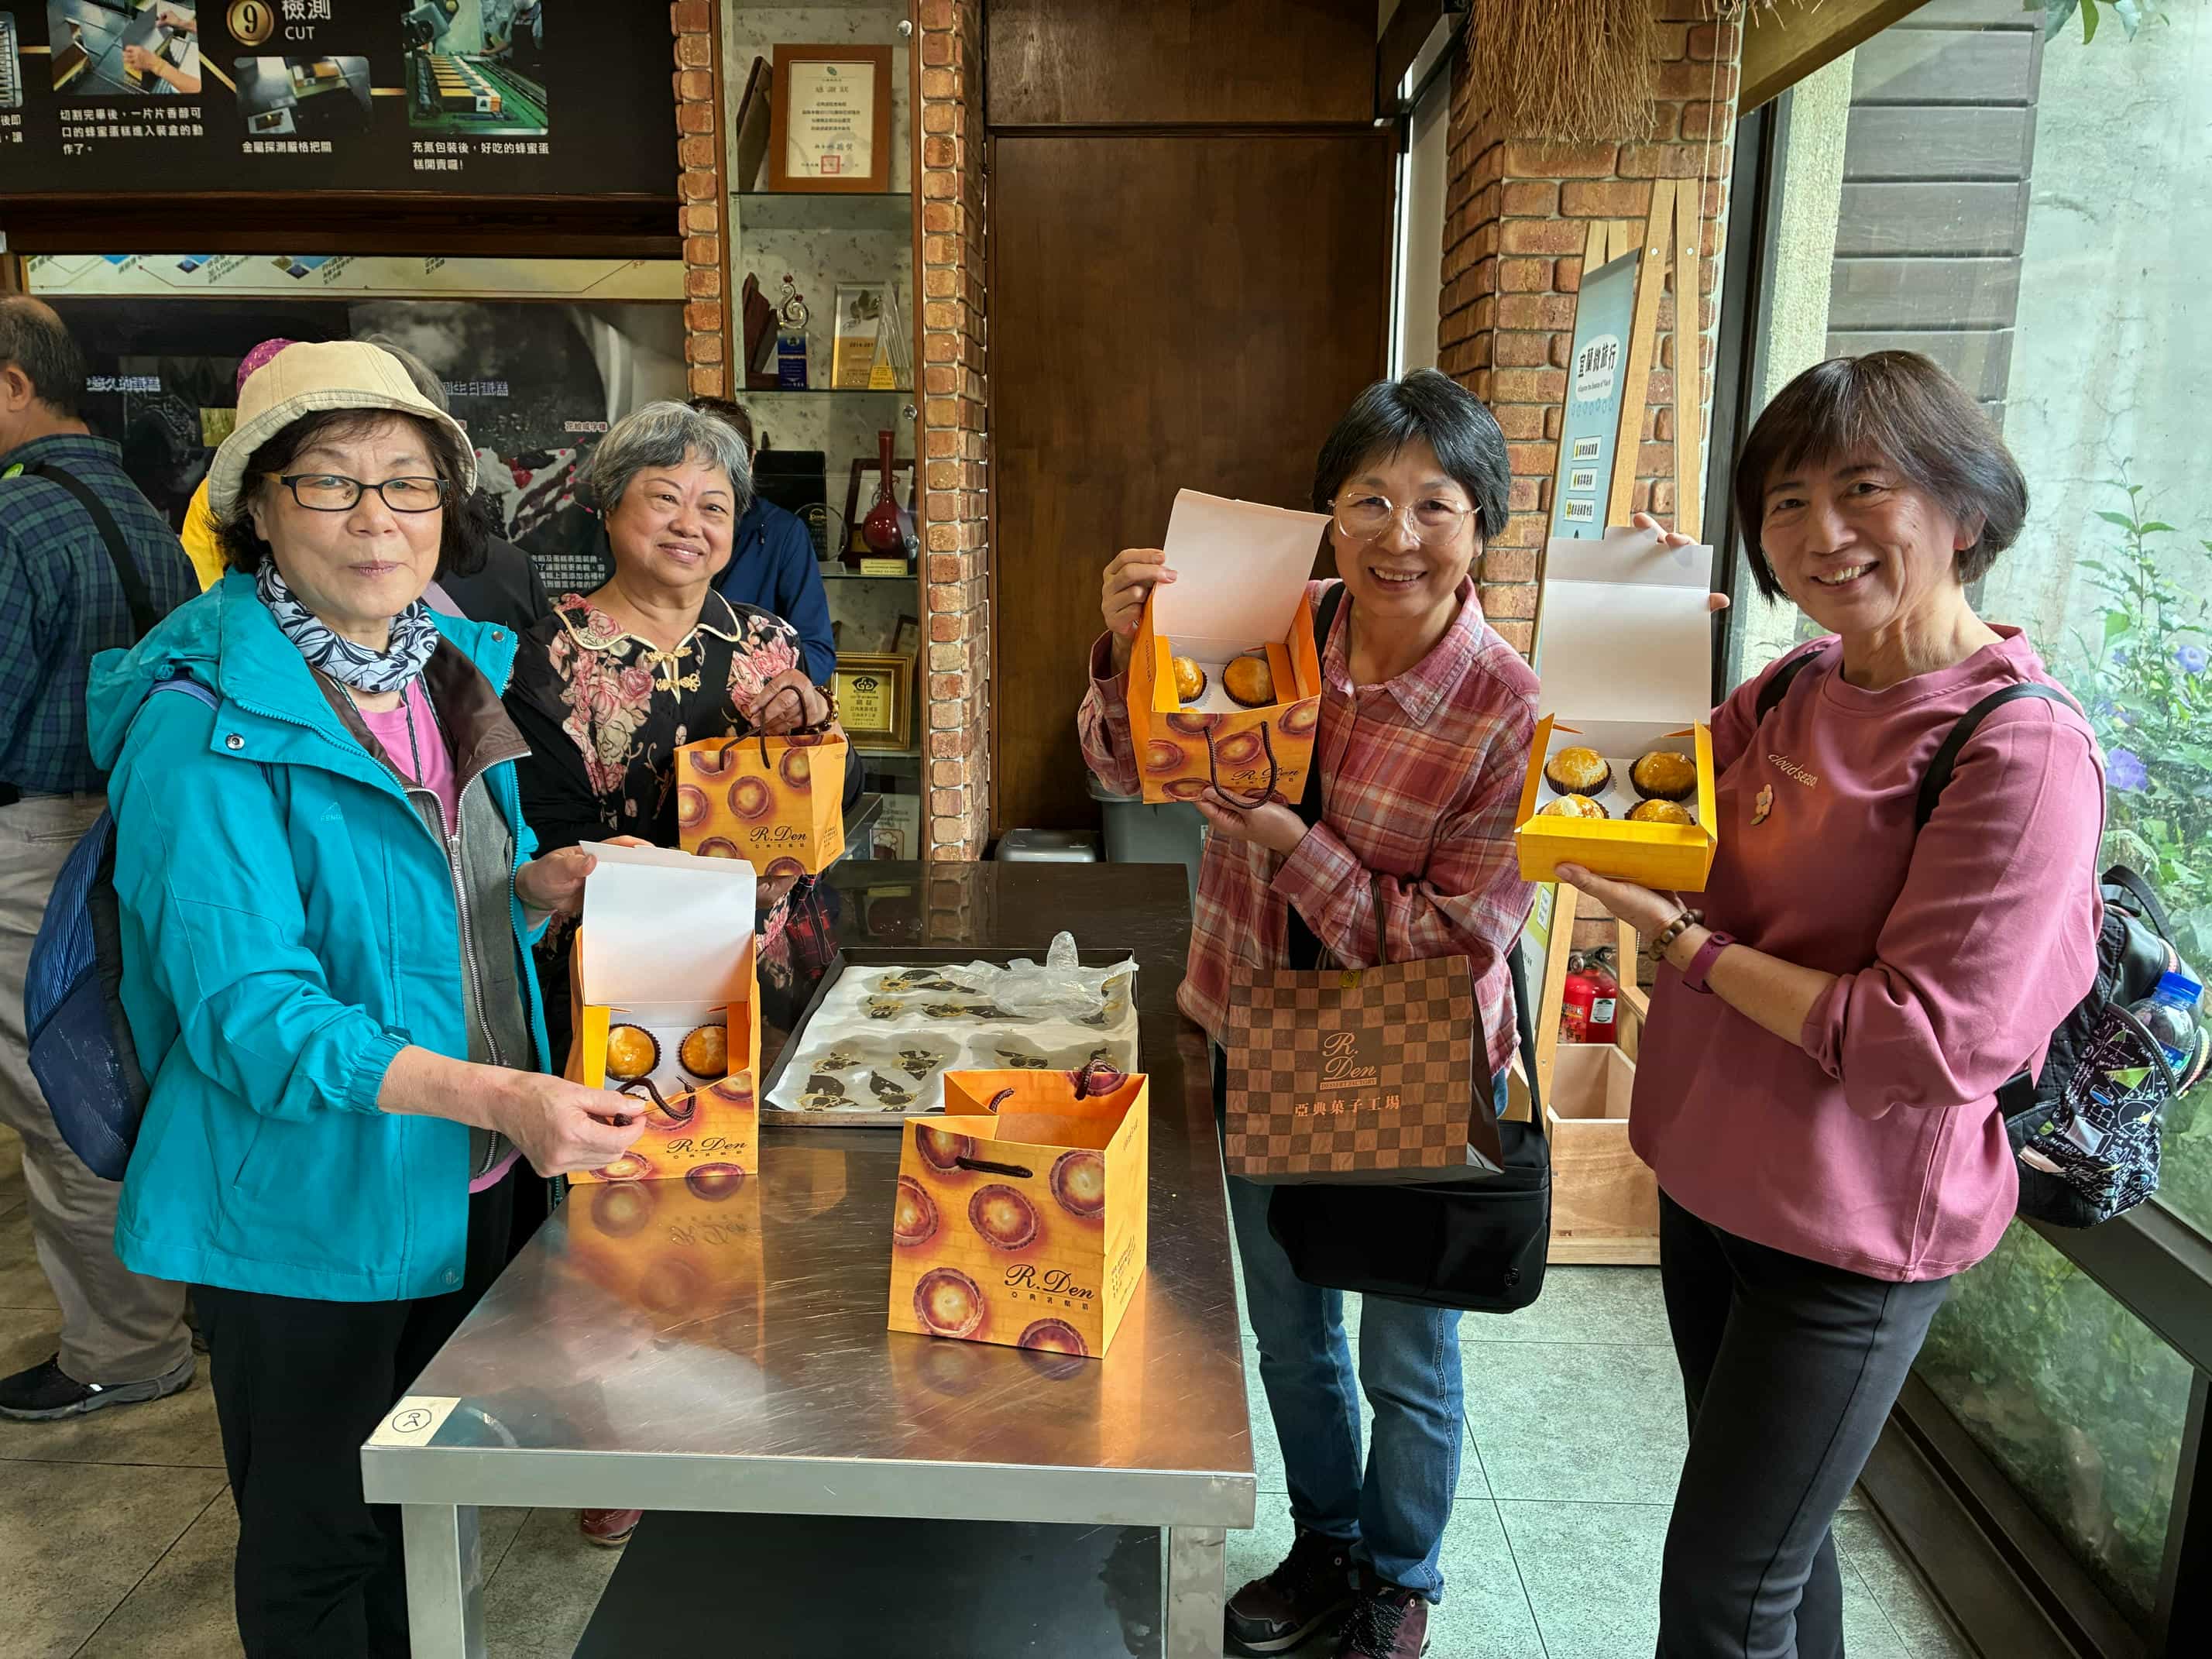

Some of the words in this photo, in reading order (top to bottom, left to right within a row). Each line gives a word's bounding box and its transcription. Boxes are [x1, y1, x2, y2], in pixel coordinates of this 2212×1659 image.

[242, 4, 259, 34] 9
[281, 0, 331, 20] 檢測
[284, 26, 315, 40] CUT
[61, 124, 204, 139] 口的蜂蜜蛋糕進入裝盒的動
[242, 141, 333, 153] 金屬探測嚴格把關
[750, 825, 807, 842] R.Den
[1322, 1032, 1358, 1056] R.
[1323, 1056, 1376, 1080] Den
[1294, 1094, 1400, 1117] 亞典菓子工場
[666, 1136, 748, 1154] R.Den
[1004, 1263, 1094, 1300] R.Den
